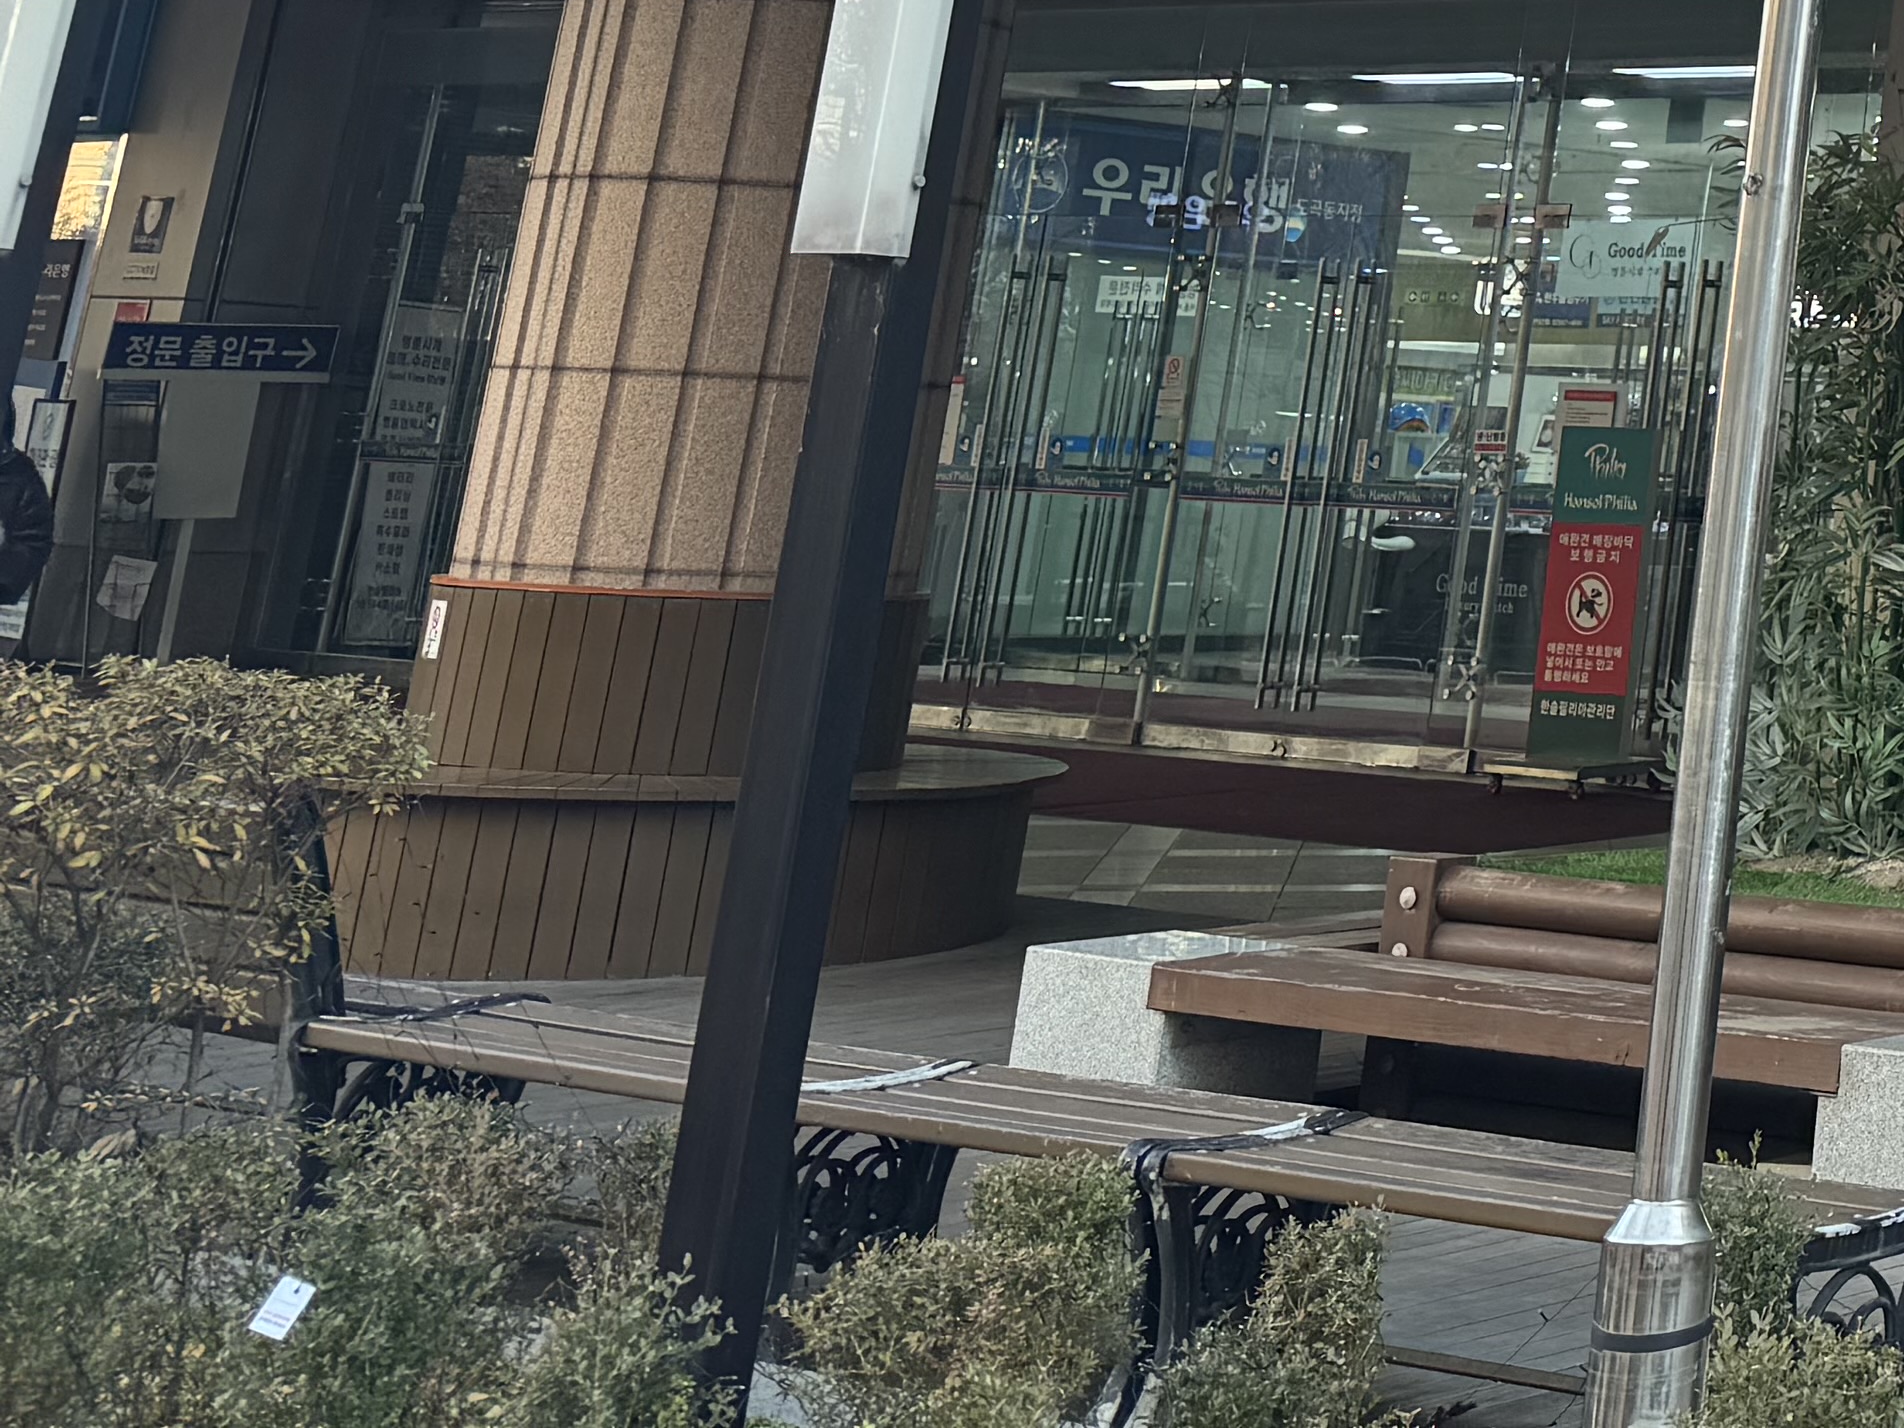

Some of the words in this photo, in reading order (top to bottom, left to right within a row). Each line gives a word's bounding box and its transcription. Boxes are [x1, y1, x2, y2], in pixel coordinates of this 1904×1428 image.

[1607, 241, 1645, 259] Good
[124, 333, 183, 367] 정문
[188, 335, 277, 367] 출입구
[1559, 532, 1590, 546] 애완견
[1497, 576, 1528, 597] ime
[1540, 698, 1616, 720] 한솔필리아관리단
